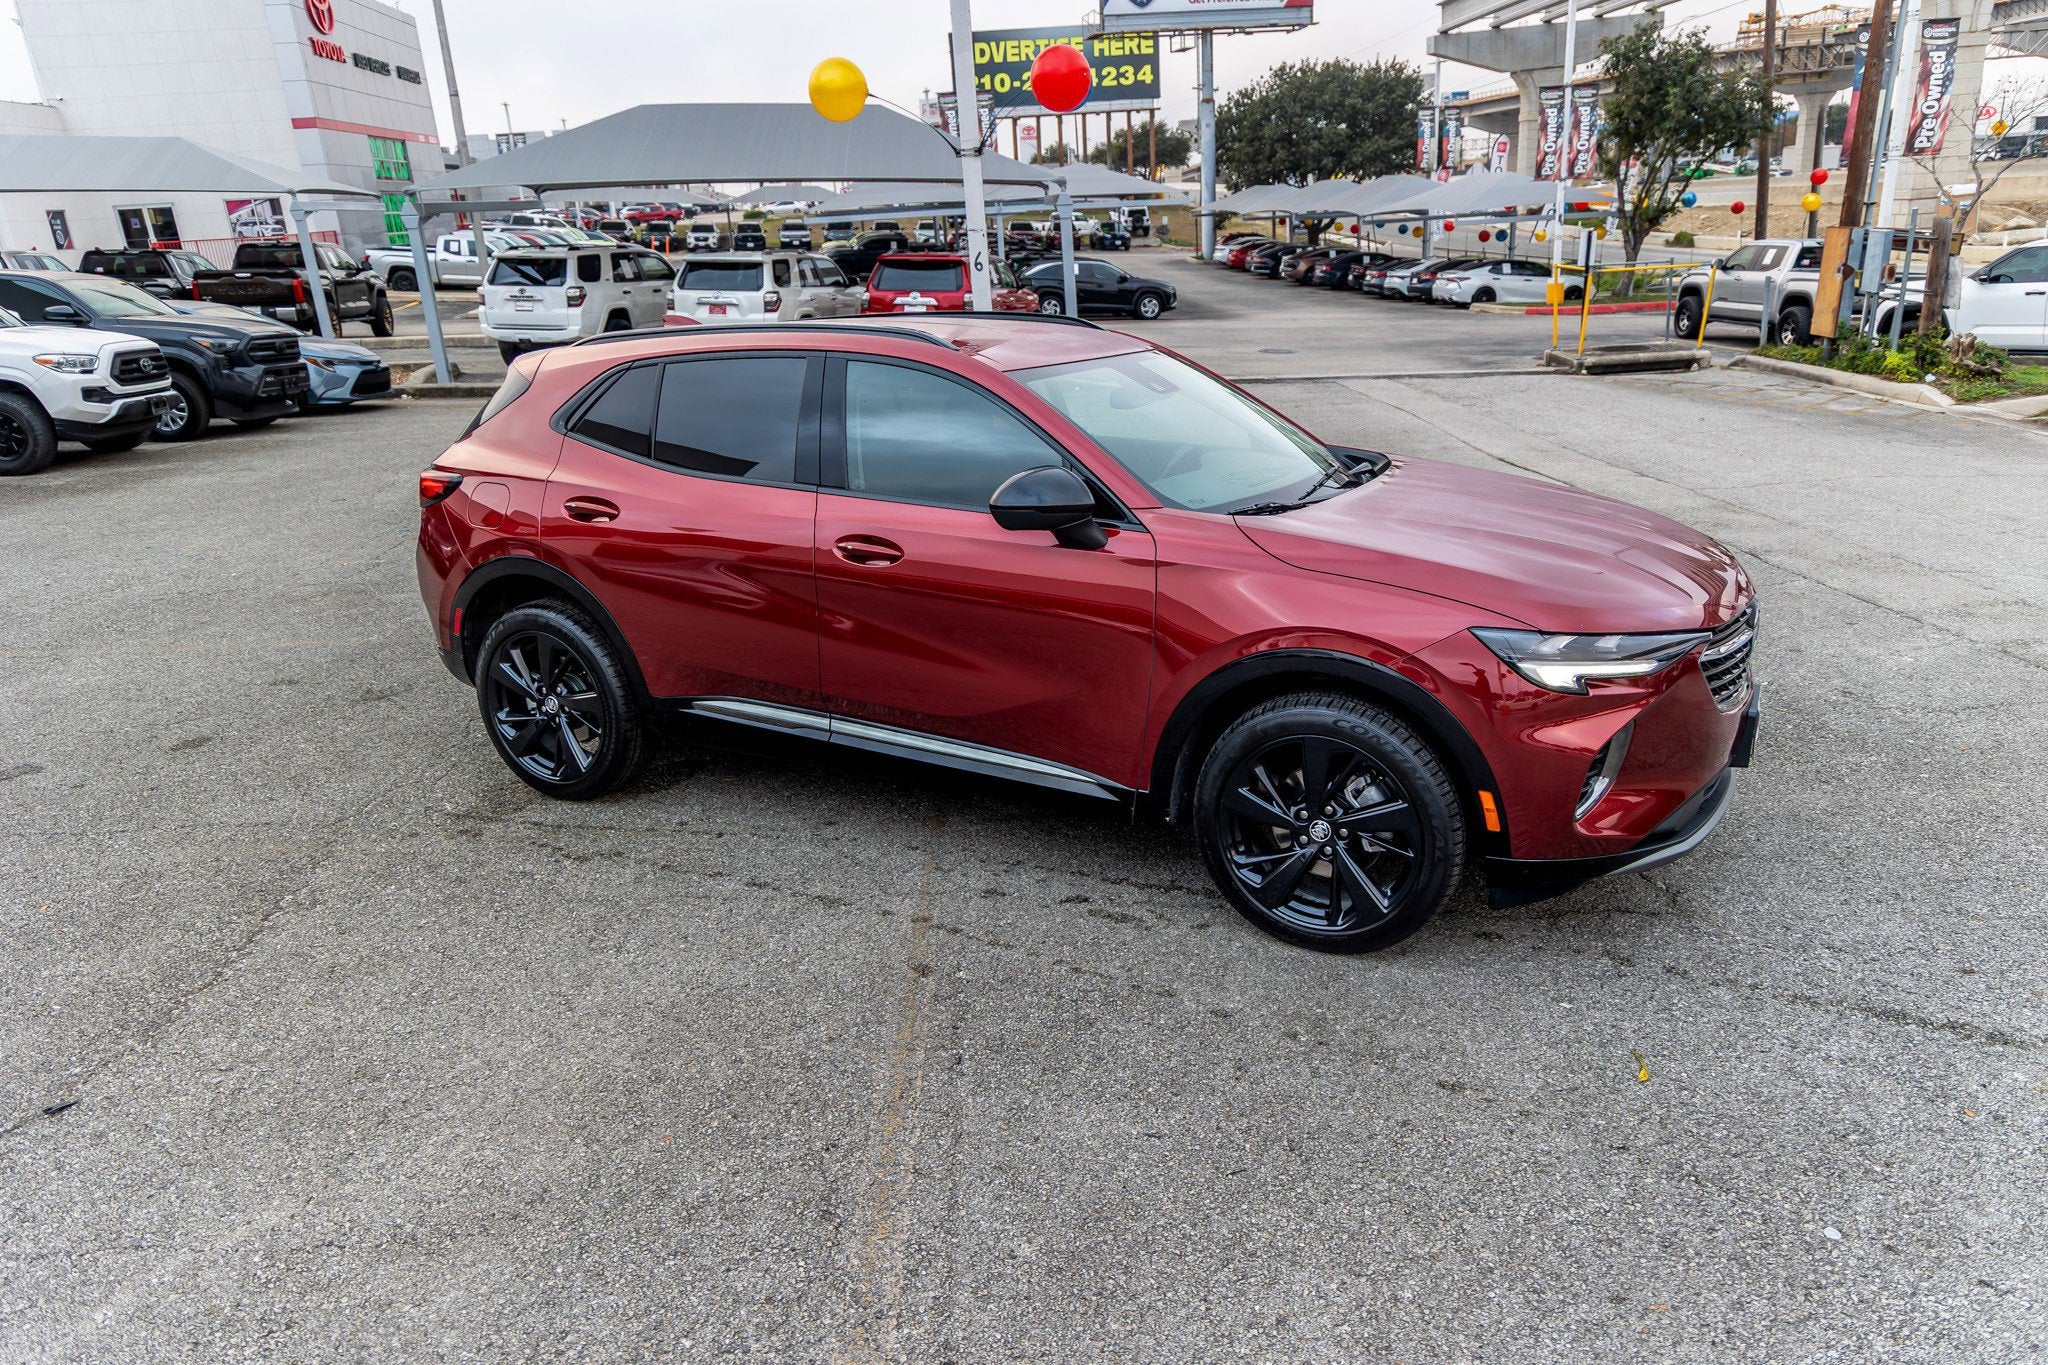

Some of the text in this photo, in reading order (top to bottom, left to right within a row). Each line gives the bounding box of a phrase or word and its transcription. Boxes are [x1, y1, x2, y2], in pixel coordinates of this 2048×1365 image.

[308, 36, 347, 63] TOYOTA
[1094, 32, 1154, 57] HERE
[1921, 50, 1947, 115] Owned
[974, 250, 984, 272] 6
